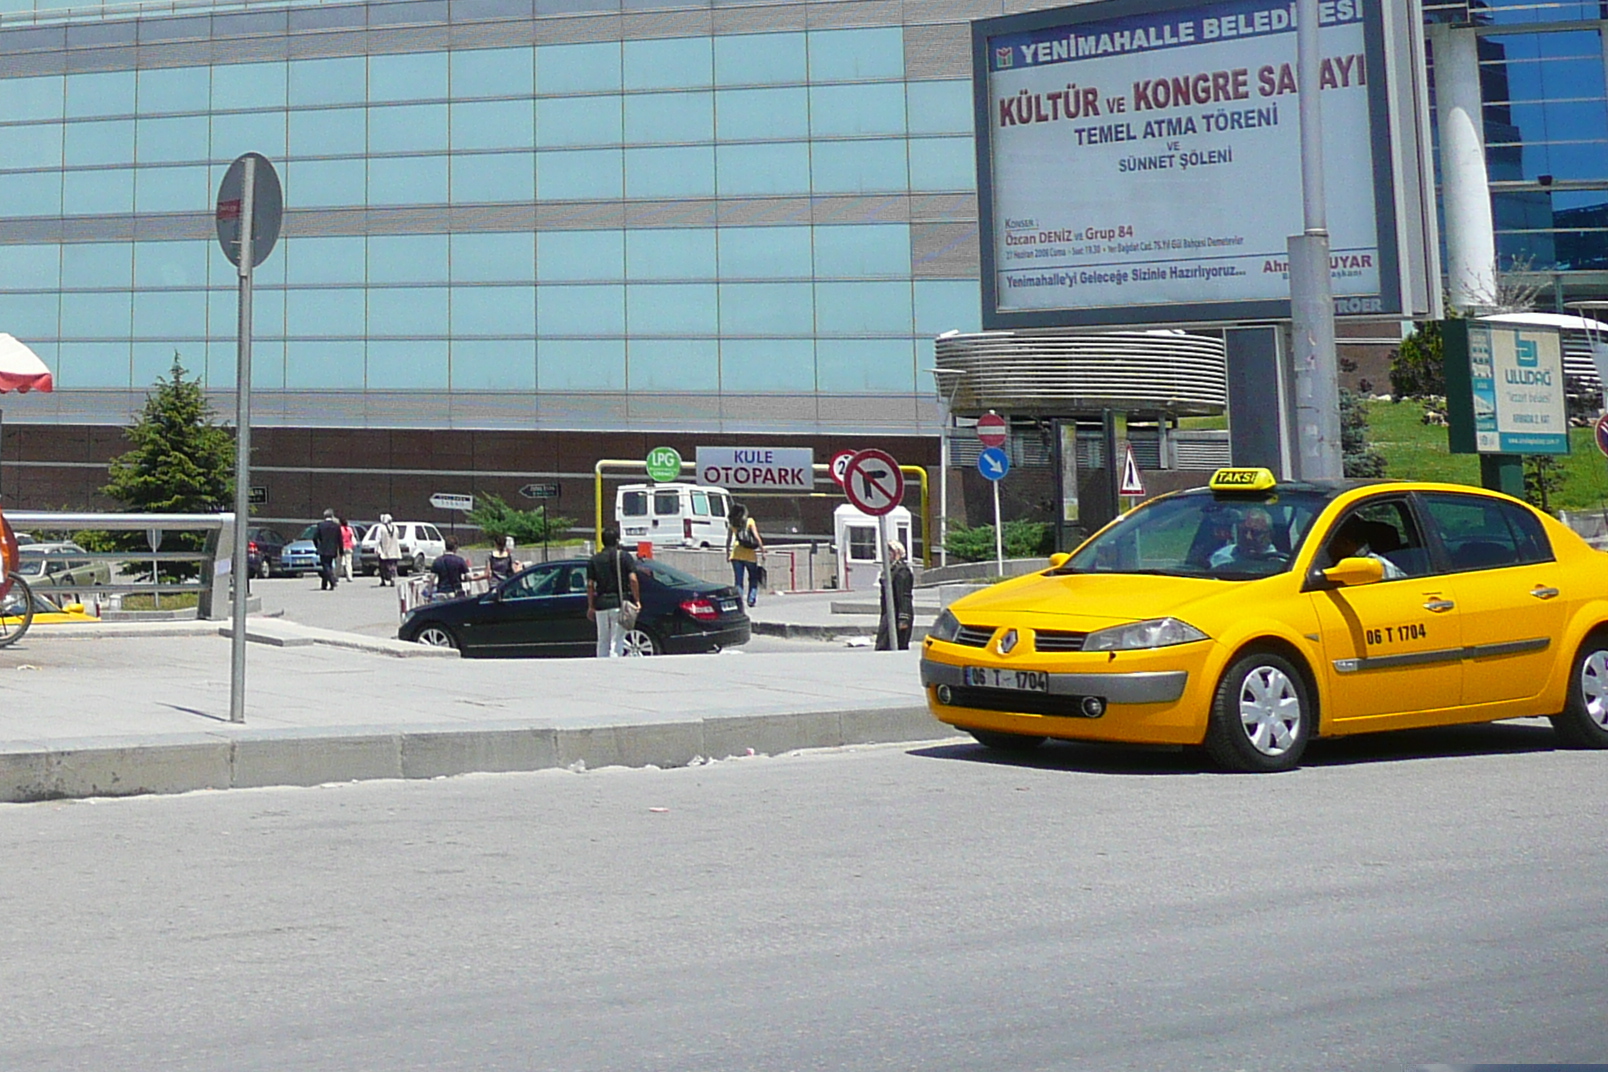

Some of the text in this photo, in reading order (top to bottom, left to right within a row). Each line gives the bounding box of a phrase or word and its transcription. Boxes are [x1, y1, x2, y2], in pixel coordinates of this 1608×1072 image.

[1020, 21, 1195, 64] YENİMAHALLE
[999, 53, 1367, 127] KÜLTÜR VE KONGRE SAAYI
[1074, 102, 1279, 145] TEMEL ATMA TÖRENİ
[1167, 141, 1181, 152] VE
[1118, 145, 1233, 172] SÜNNET ŞÖLENİ
[1005, 230, 1036, 246] Özcan
[1039, 228, 1072, 244] DENİZ
[1085, 227, 1115, 242] Grup
[1118, 225, 1133, 238] 84
[1006, 272, 1077, 288] Yenimahalle'yi
[1080, 270, 1128, 285] Geleceğe
[1132, 267, 1166, 281] Sizinle
[1329, 255, 1372, 269] UYAR
[652, 452, 675, 467] LPG
[734, 450, 773, 463] KULE
[703, 466, 805, 485] OTOPARK
[1366, 623, 1427, 645] 06 T 1704
[972, 668, 1046, 690] 06 T 1704
